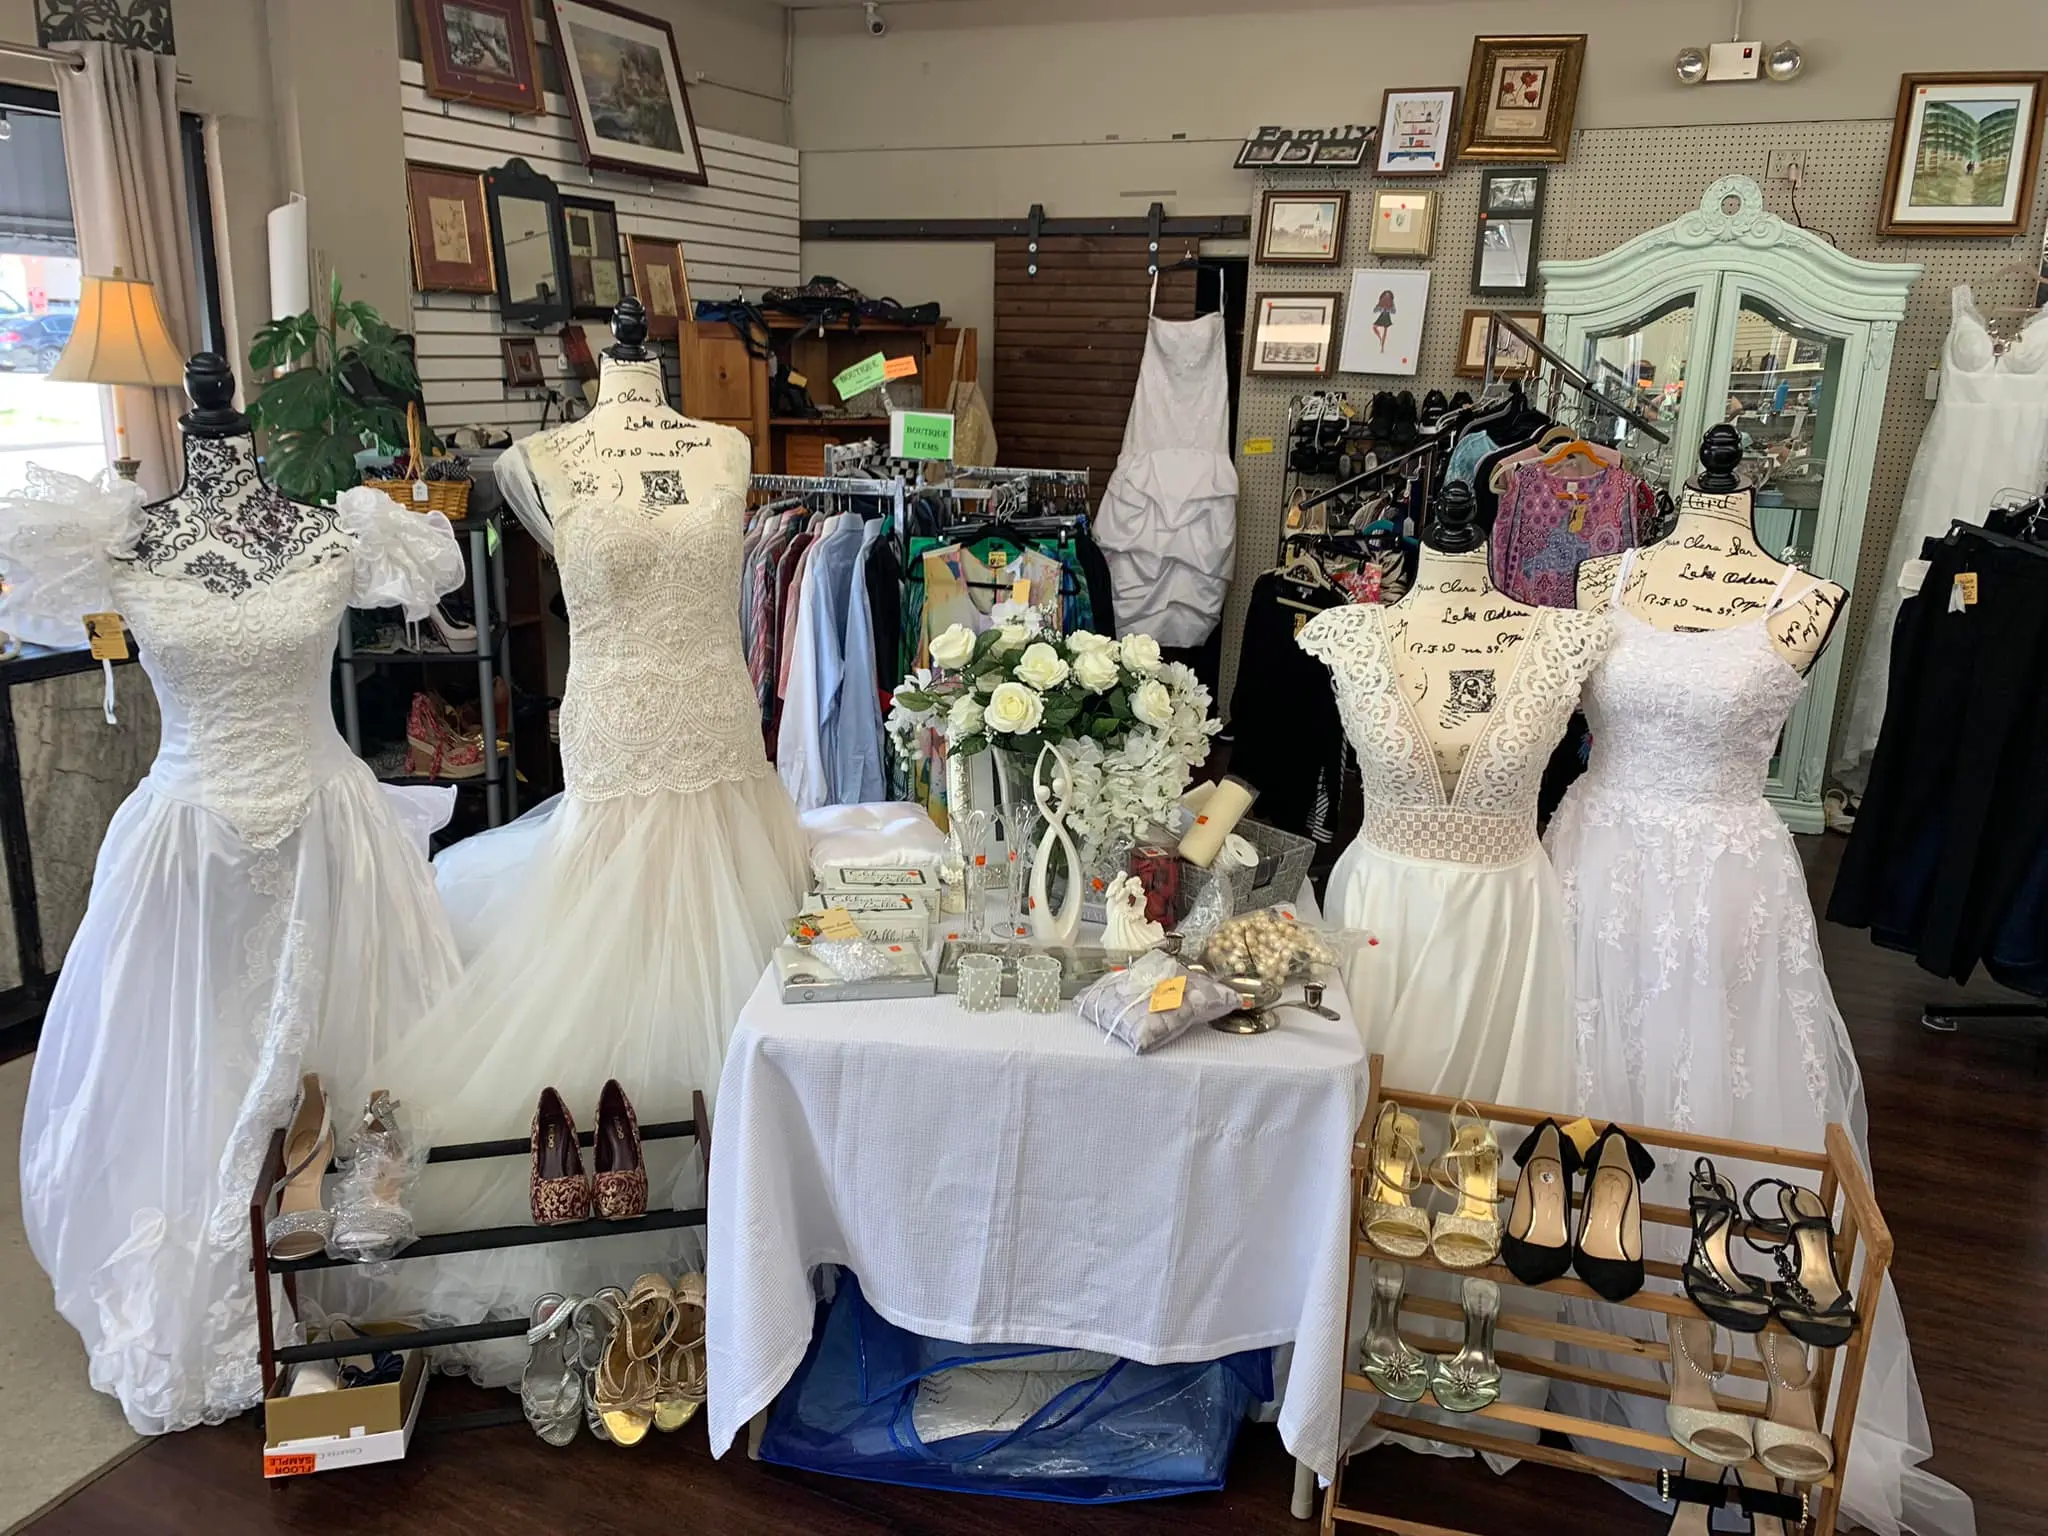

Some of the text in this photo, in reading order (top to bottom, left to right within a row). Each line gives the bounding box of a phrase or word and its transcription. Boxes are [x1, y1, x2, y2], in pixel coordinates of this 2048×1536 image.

[1256, 125, 1376, 141] Family
[906, 426, 948, 438] BOUTIQUE
[913, 441, 939, 451] ITEMS
[270, 1456, 312, 1466] SAMPLE
